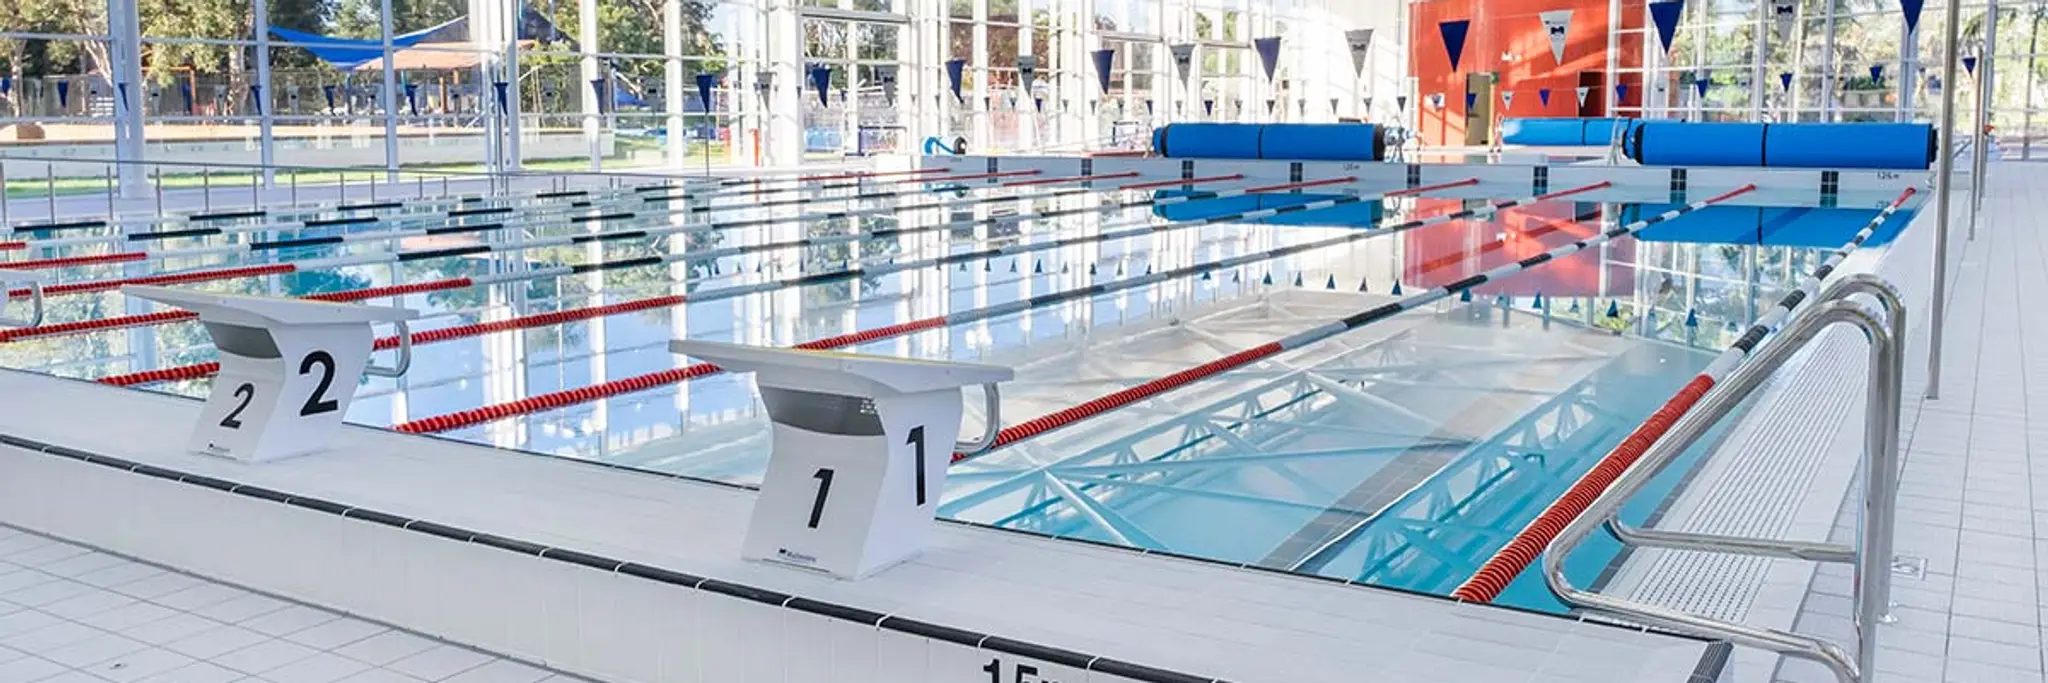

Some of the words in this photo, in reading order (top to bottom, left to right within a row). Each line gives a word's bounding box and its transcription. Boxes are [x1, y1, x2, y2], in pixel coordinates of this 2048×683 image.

[219, 382, 255, 430] 2
[299, 350, 339, 417] 2
[906, 424, 926, 507] 1
[807, 467, 835, 529] 1
